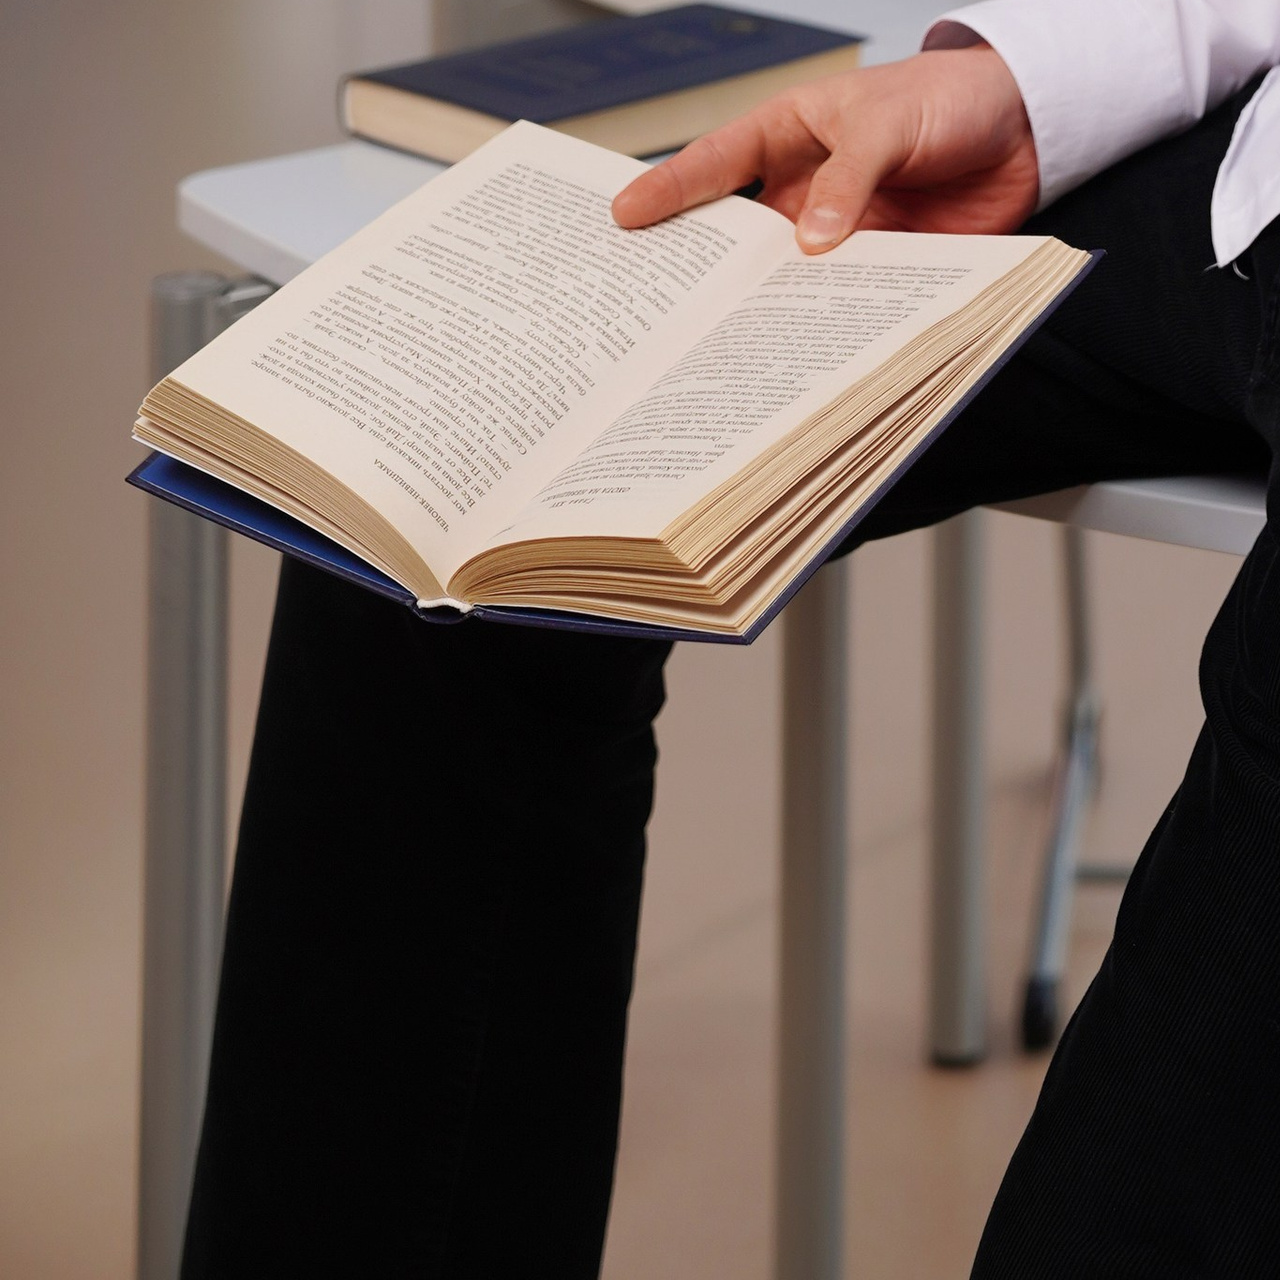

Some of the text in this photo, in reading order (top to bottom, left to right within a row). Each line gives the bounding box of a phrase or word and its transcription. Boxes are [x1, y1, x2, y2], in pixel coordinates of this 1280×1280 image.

[281, 376, 293, 385] на
[286, 366, 317, 386] холода
[294, 358, 345, 389] участвовать
[294, 382, 316, 399] быть
[315, 382, 340, 400] были
[345, 387, 383, 411] должны
[275, 337, 494, 490] те! Поймите, Эдай, его надо поймать во что бы то ни
[315, 395, 351, 418] должно
[339, 396, 367, 417] чтобы
[402, 396, 433, 418] грозят
[429, 398, 466, 429] страшно.
[349, 415, 367, 430] Все
[369, 413, 387, 429] бог,
[381, 409, 412, 432] велика
[431, 416, 450, 431] нам
[368, 426, 387, 443] еды.
[385, 426, 406, 442] Дай
[411, 430, 425, 441] до
[450, 430, 478, 456] Иначе
[465, 427, 477, 439] то
[385, 440, 423, 470] никакой
[402, 438, 431, 461] запор!
[423, 438, 446, 458] мала
[484, 443, 512, 472] думать
[430, 460, 443, 472] на
[444, 457, 457, 468] от
[475, 453, 502, 481] стало!
[422, 468, 455, 500] достать
[441, 469, 464, 491] дома
[456, 467, 472, 486] Все
[373, 458, 449, 533] ЧЕЛОВЕК-НЕВИДИМКА
[460, 489, 476, 508] Все
[470, 483, 486, 498] ди!
[451, 499, 468, 516] мог
